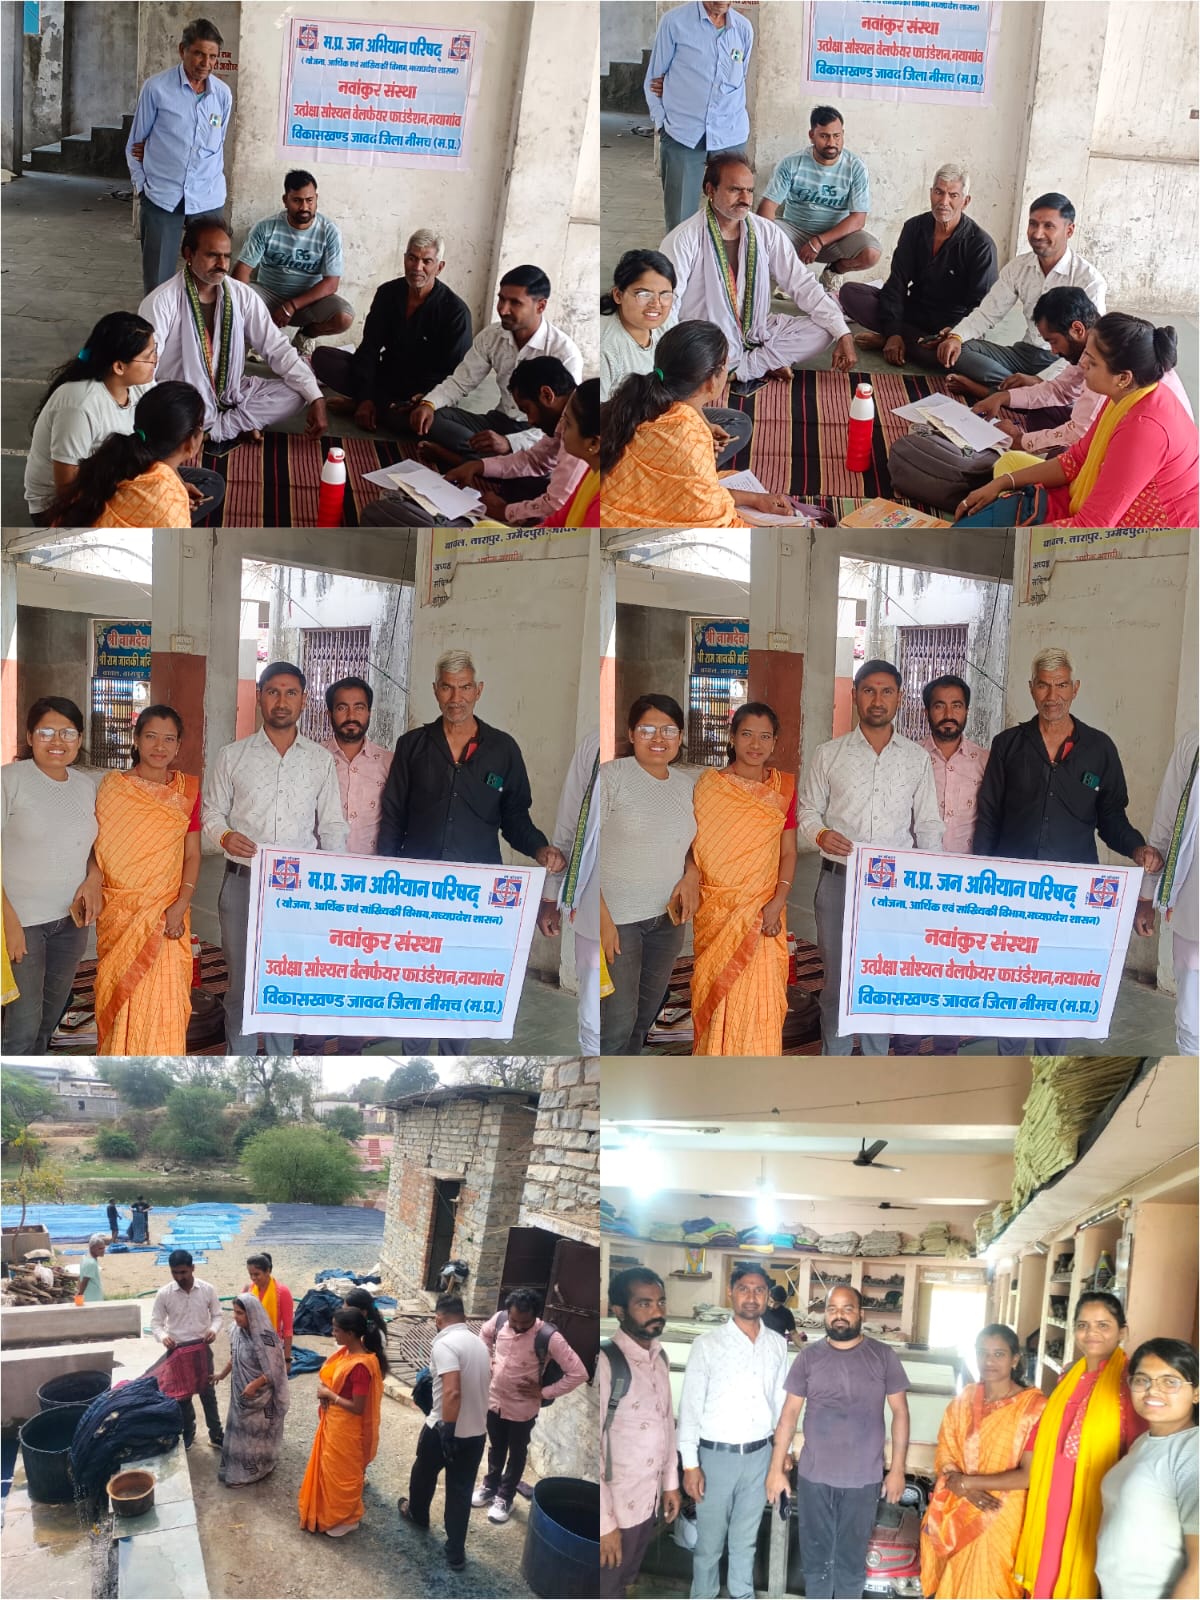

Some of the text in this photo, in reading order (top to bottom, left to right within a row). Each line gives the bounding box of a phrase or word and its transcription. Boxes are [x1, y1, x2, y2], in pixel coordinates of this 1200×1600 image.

[861, 14, 939, 36] नवांकुर संस्था
[323, 33, 442, 62] म.प्र. जन अभियान परिषद्
[876, 40, 911, 58] वेलफेयर
[815, 59, 873, 77] विकासखण्ड
[875, 67, 900, 79] जावद
[903, 66, 927, 81] जिला
[929, 67, 954, 84] नीमच
[338, 78, 417, 100] नवांकुर संस्था
[353, 104, 388, 121] वेलफेयर
[292, 124, 348, 142] विकासखण्ड
[350, 131, 376, 144] जावद
[379, 130, 403, 146] जिला
[405, 132, 432, 148] नीमच
[308, 870, 337, 891] म.प्र.
[340, 873, 367, 893] जन
[370, 869, 430, 899] अभियान
[432, 875, 481, 909] परिषद्
[904, 868, 1078, 909] म.प्र. जन अभियान परिषद्
[314, 900, 345, 913] आर्थिक
[346, 904, 360, 914] एवं
[910, 899, 941, 912] आर्थिक
[942, 903, 956, 913] एवं
[329, 926, 443, 954] नवांकुर संस्था
[925, 926, 1039, 954] नवांकुर संस्था
[350, 958, 401, 981] वेलफेयर
[945, 958, 996, 981] वेलफेयर
[263, 986, 345, 1007] विकासखण्ड
[347, 993, 385, 1008] जावद
[387, 991, 422, 1011] जिला
[423, 994, 462, 1012] नीमच
[858, 985, 940, 1006] विकासखण्ड
[943, 993, 979, 1008] जावद
[982, 991, 1017, 1010] जिला
[1019, 993, 1058, 1012] नीमच
